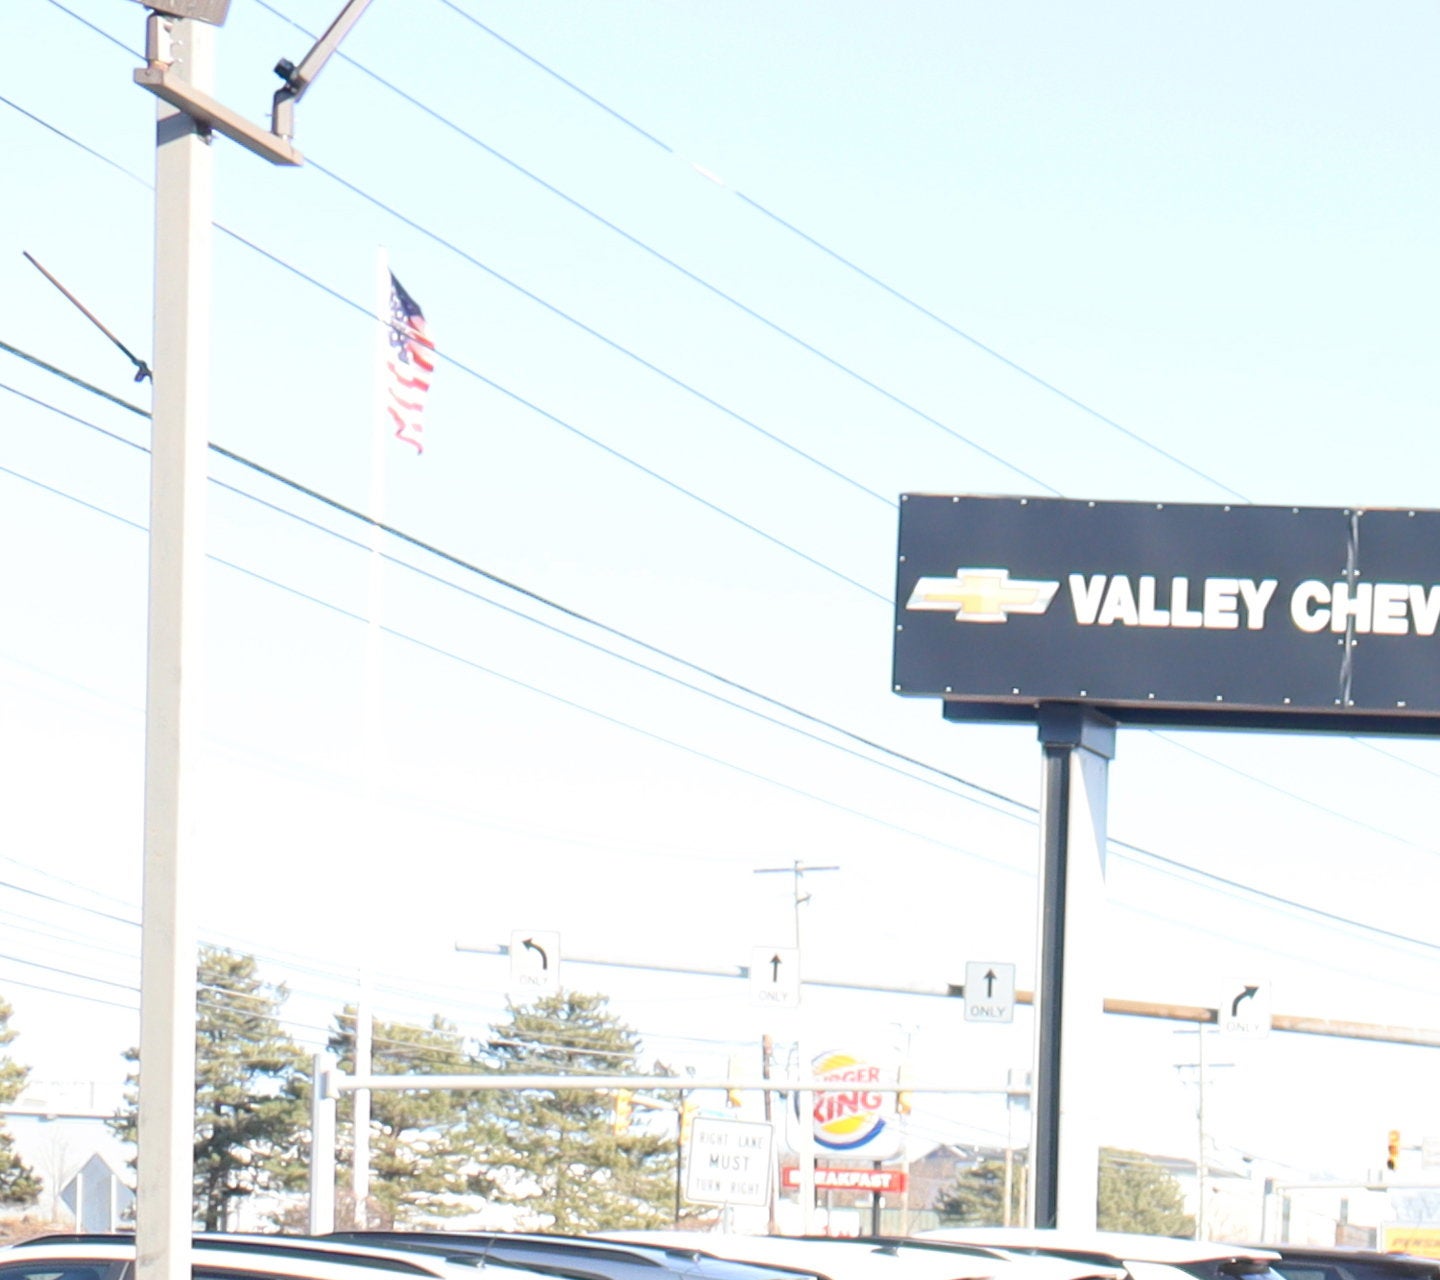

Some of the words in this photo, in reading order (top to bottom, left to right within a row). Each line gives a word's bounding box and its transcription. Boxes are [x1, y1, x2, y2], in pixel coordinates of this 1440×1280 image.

[1069, 574, 1277, 629] VALLEY
[519, 975, 549, 987] ONLY
[758, 990, 788, 1003] ONLY
[970, 1005, 1006, 1019] ONLY
[1226, 1022, 1260, 1033] ONLY
[700, 1131, 729, 1148] RIGHT
[738, 1134, 764, 1150] LANE
[709, 1153, 751, 1172] MUST
[696, 1177, 721, 1193] TURN
[730, 1180, 760, 1196] RIGHT
[790, 1169, 892, 1188] BEAKFAST
